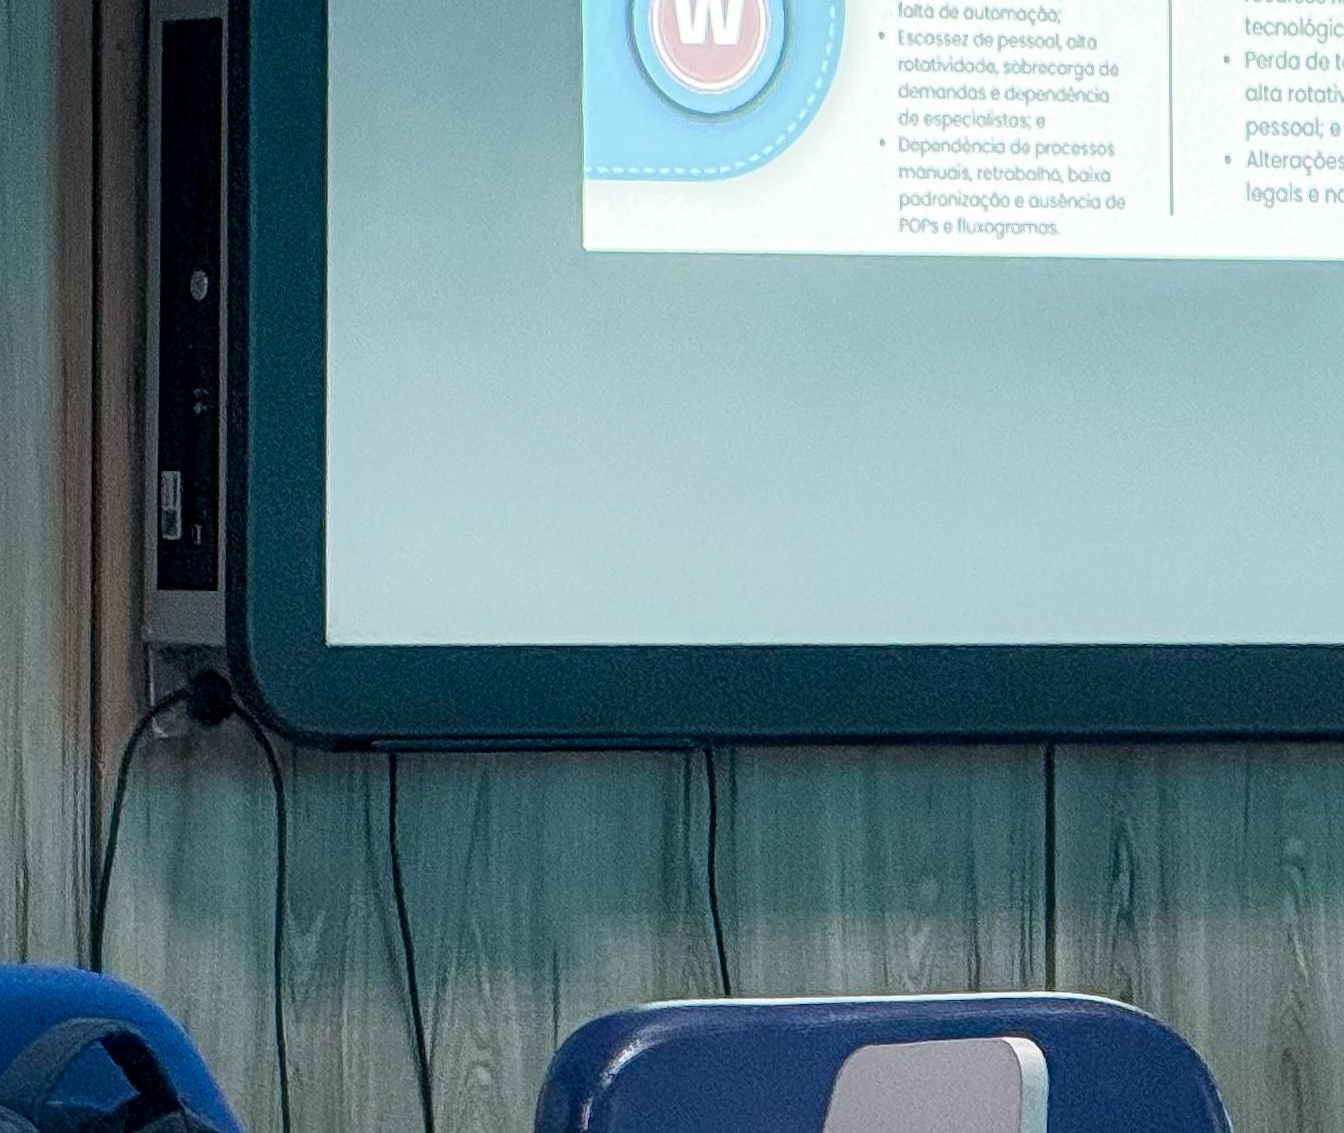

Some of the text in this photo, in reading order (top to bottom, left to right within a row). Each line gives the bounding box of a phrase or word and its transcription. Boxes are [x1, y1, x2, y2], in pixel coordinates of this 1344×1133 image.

[897, 2, 934, 19] falta
[939, 2, 959, 19] de
[898, 29, 1097, 52] Escassez de pessoal, alta
[898, 55, 1119, 81] rotatividade, sobrecarga de
[1245, 50, 1300, 71] Perda
[1305, 51, 1330, 71] de
[898, 84, 1109, 106] demandas e dependência
[1245, 83, 1282, 102] alta
[898, 108, 918, 127] de
[1036, 115, 1046, 129] e
[1329, 121, 1341, 137] e
[898, 136, 1115, 159] Dependência de processos
[898, 164, 1110, 184] manuais, retrabalho, baixa
[899, 189, 1126, 212] padronização e ausência de
[1246, 182, 1303, 209] legais
[1308, 187, 1319, 203] e
[899, 217, 1060, 240] POPs e fluxogramas.
